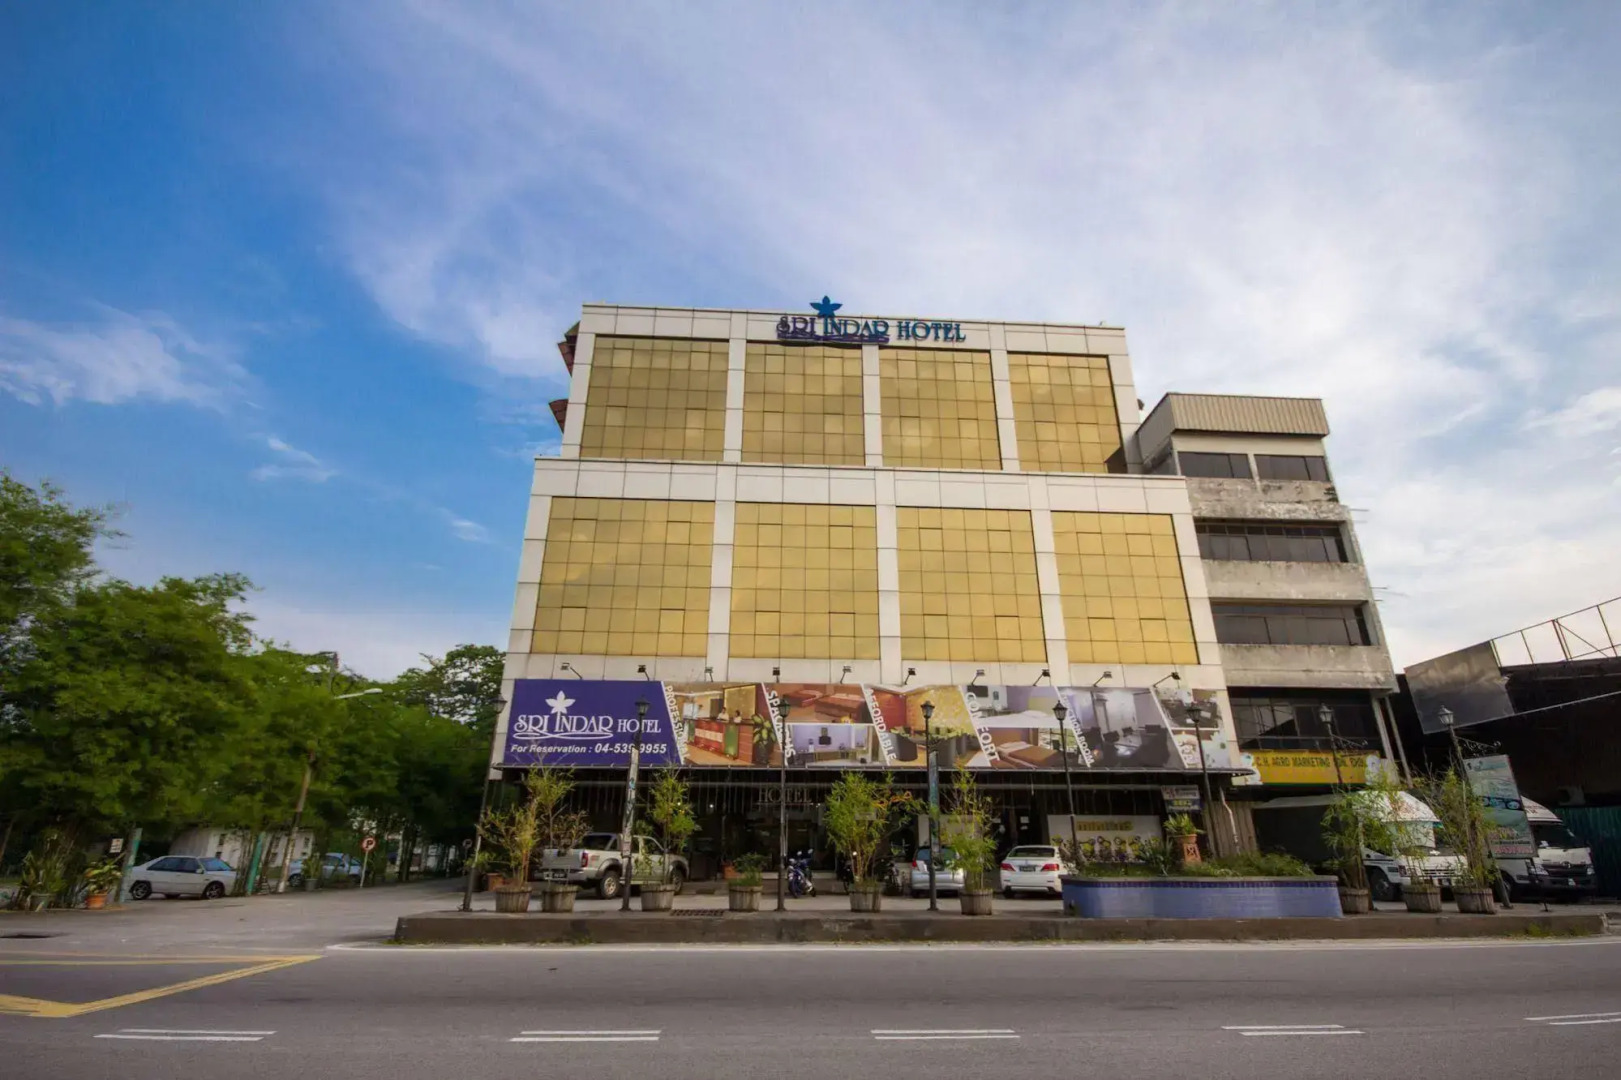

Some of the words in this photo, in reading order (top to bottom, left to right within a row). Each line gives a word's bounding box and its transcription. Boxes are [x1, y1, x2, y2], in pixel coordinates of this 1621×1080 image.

[776, 316, 816, 336] SRI
[822, 316, 890, 338] INDAR
[897, 320, 967, 342] HOTEL
[514, 714, 550, 733] SRI
[553, 711, 614, 734] INDAR
[616, 718, 661, 733] HOTEL
[864, 687, 897, 761] AFFORDABLE
[965, 691, 1001, 762] COMFORT
[510, 744, 528, 753] For
[530, 743, 587, 754] Reservation
[758, 787, 813, 803] HOTEL
